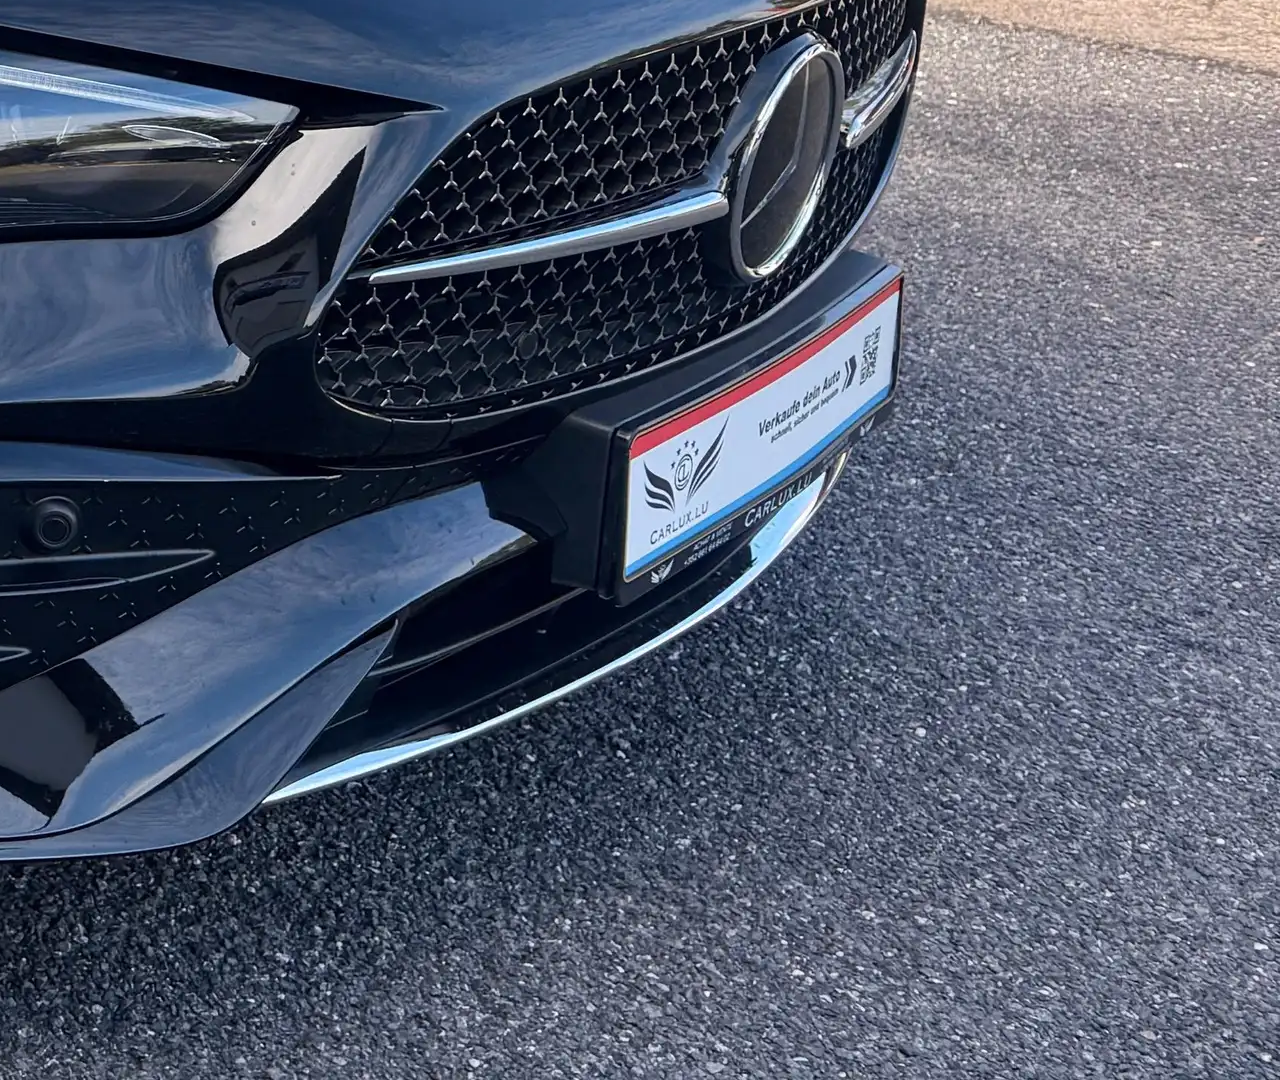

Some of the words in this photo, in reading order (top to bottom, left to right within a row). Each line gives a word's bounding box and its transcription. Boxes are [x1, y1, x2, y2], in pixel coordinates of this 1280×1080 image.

[759, 399, 801, 437] Verkaufe
[803, 385, 821, 408] dein
[822, 370, 841, 393] Auto
[649, 500, 709, 545] CARLUX.LU
[744, 472, 813, 528] CARLUX.LU
